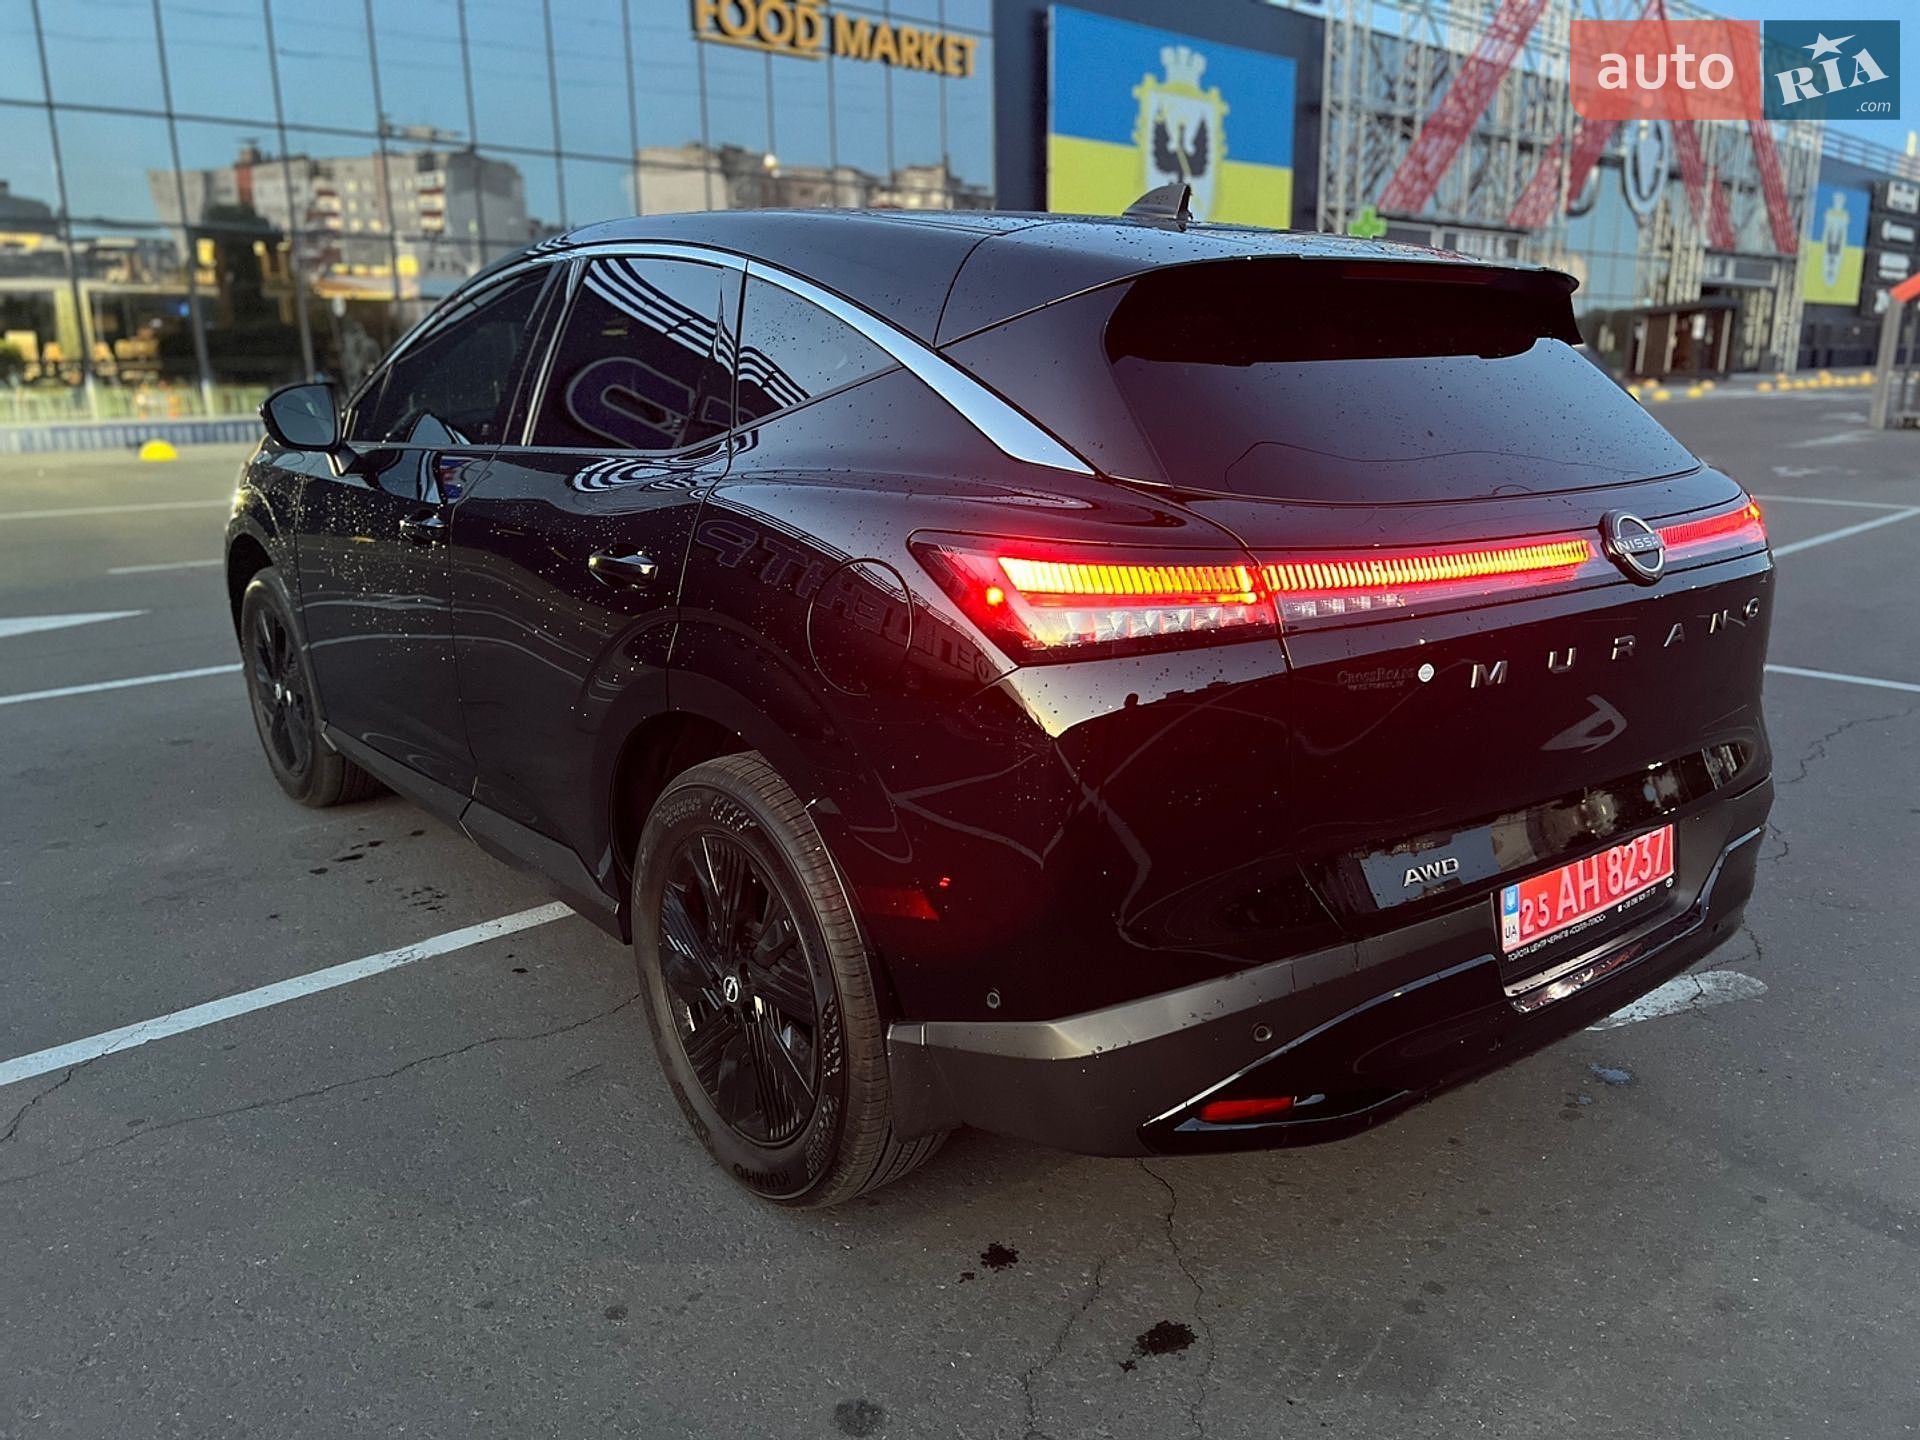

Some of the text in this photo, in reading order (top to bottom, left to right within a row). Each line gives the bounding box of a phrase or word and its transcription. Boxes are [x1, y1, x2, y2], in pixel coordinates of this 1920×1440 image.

[693, 0, 977, 77] FOOD MARKET
[1617, 537, 1659, 552] NISSA
[1470, 597, 1760, 689] MURANO
[1400, 854, 1461, 878] AWD
[1521, 826, 1665, 934] 25 AH 8237
[1505, 924, 1517, 939] UA
